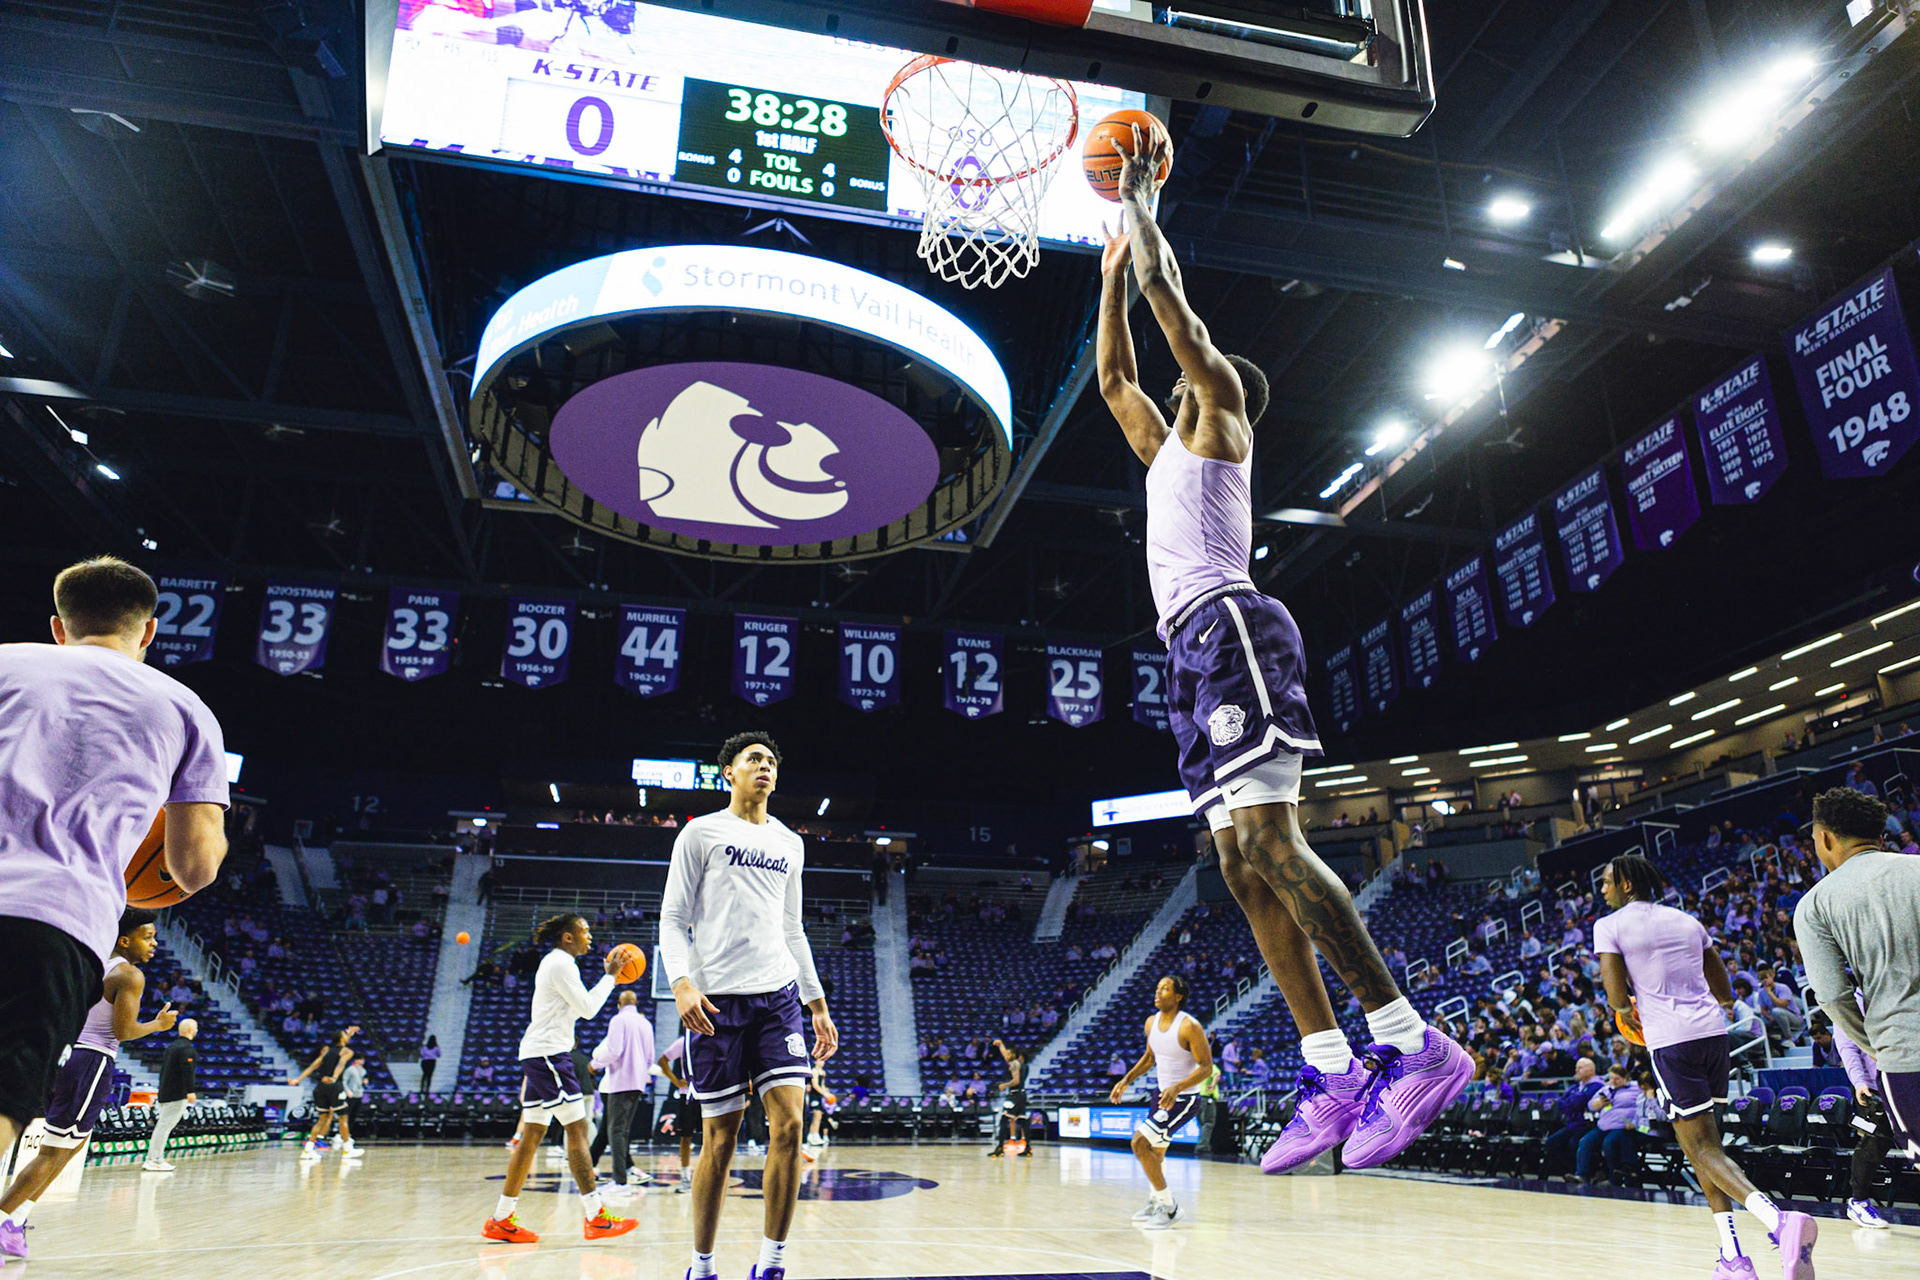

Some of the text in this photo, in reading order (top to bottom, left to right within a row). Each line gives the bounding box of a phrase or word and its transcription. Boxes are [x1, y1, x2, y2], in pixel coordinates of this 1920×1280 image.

[532, 58, 660, 92] K-STATE
[566, 96, 614, 157] 0
[725, 88, 848, 137] 38:28
[756, 130, 779, 149] 1st
[948, 125, 993, 147] OSU
[678, 151, 716, 165] BONUS
[728, 148, 836, 178] 4 TOL 4
[726, 167, 835, 197] 0 FOULS 0
[849, 177, 885, 191] BONUS
[517, 294, 579, 335] Health
[684, 264, 976, 368] Stormont Vail Health
[1795, 278, 1885, 353] K-STATE
[1803, 301, 1883, 357] MEN'S BASKETBALL
[1815, 334, 1888, 390] FINAL
[1701, 361, 1759, 412] K-STATE
[1821, 353, 1893, 410] FOUR
[1709, 398, 1765, 441] ELITE EIGHT
[1828, 390, 1911, 454] 1948
[1625, 419, 1675, 463] K-STATE
[1717, 435, 1736, 452] 1951
[1747, 428, 1768, 446] 1972
[1749, 439, 1771, 457] 1973
[1652, 449, 1684, 478] SIXTEEN
[1752, 450, 1774, 469] 1975
[1557, 471, 1600, 509] K-STATE
[1496, 514, 1535, 549] K-STATE
[160, 577, 218, 591] BARRETT
[1447, 558, 1480, 589] K-STATE
[267, 586, 334, 600] KNOSTMAN
[408, 595, 439, 606] PARR
[156, 592, 215, 637] 22
[261, 600, 327, 645] 33
[518, 603, 565, 615] BOOZER
[627, 612, 678, 625] MURRELL
[387, 608, 449, 651] 33
[507, 616, 568, 660] 30
[744, 621, 788, 633] KRUGER
[844, 629, 896, 641] WILLIAMS
[621, 626, 678, 669] 44
[739, 635, 790, 677] 12
[957, 638, 991, 649] EVANS
[1047, 646, 1102, 658] BLACKMAN
[516, 663, 554, 673] 1956-59
[629, 672, 666, 683] 1962-64
[844, 643, 894, 684] 10
[950, 651, 998, 692] 12
[745, 681, 781, 691] 1971-74
[851, 688, 886, 698] 1972-76
[1051, 659, 1100, 700] 25
[352, 795, 380, 813] 12
[969, 826, 991, 843] 15
[725, 845, 789, 874] Wildcats
